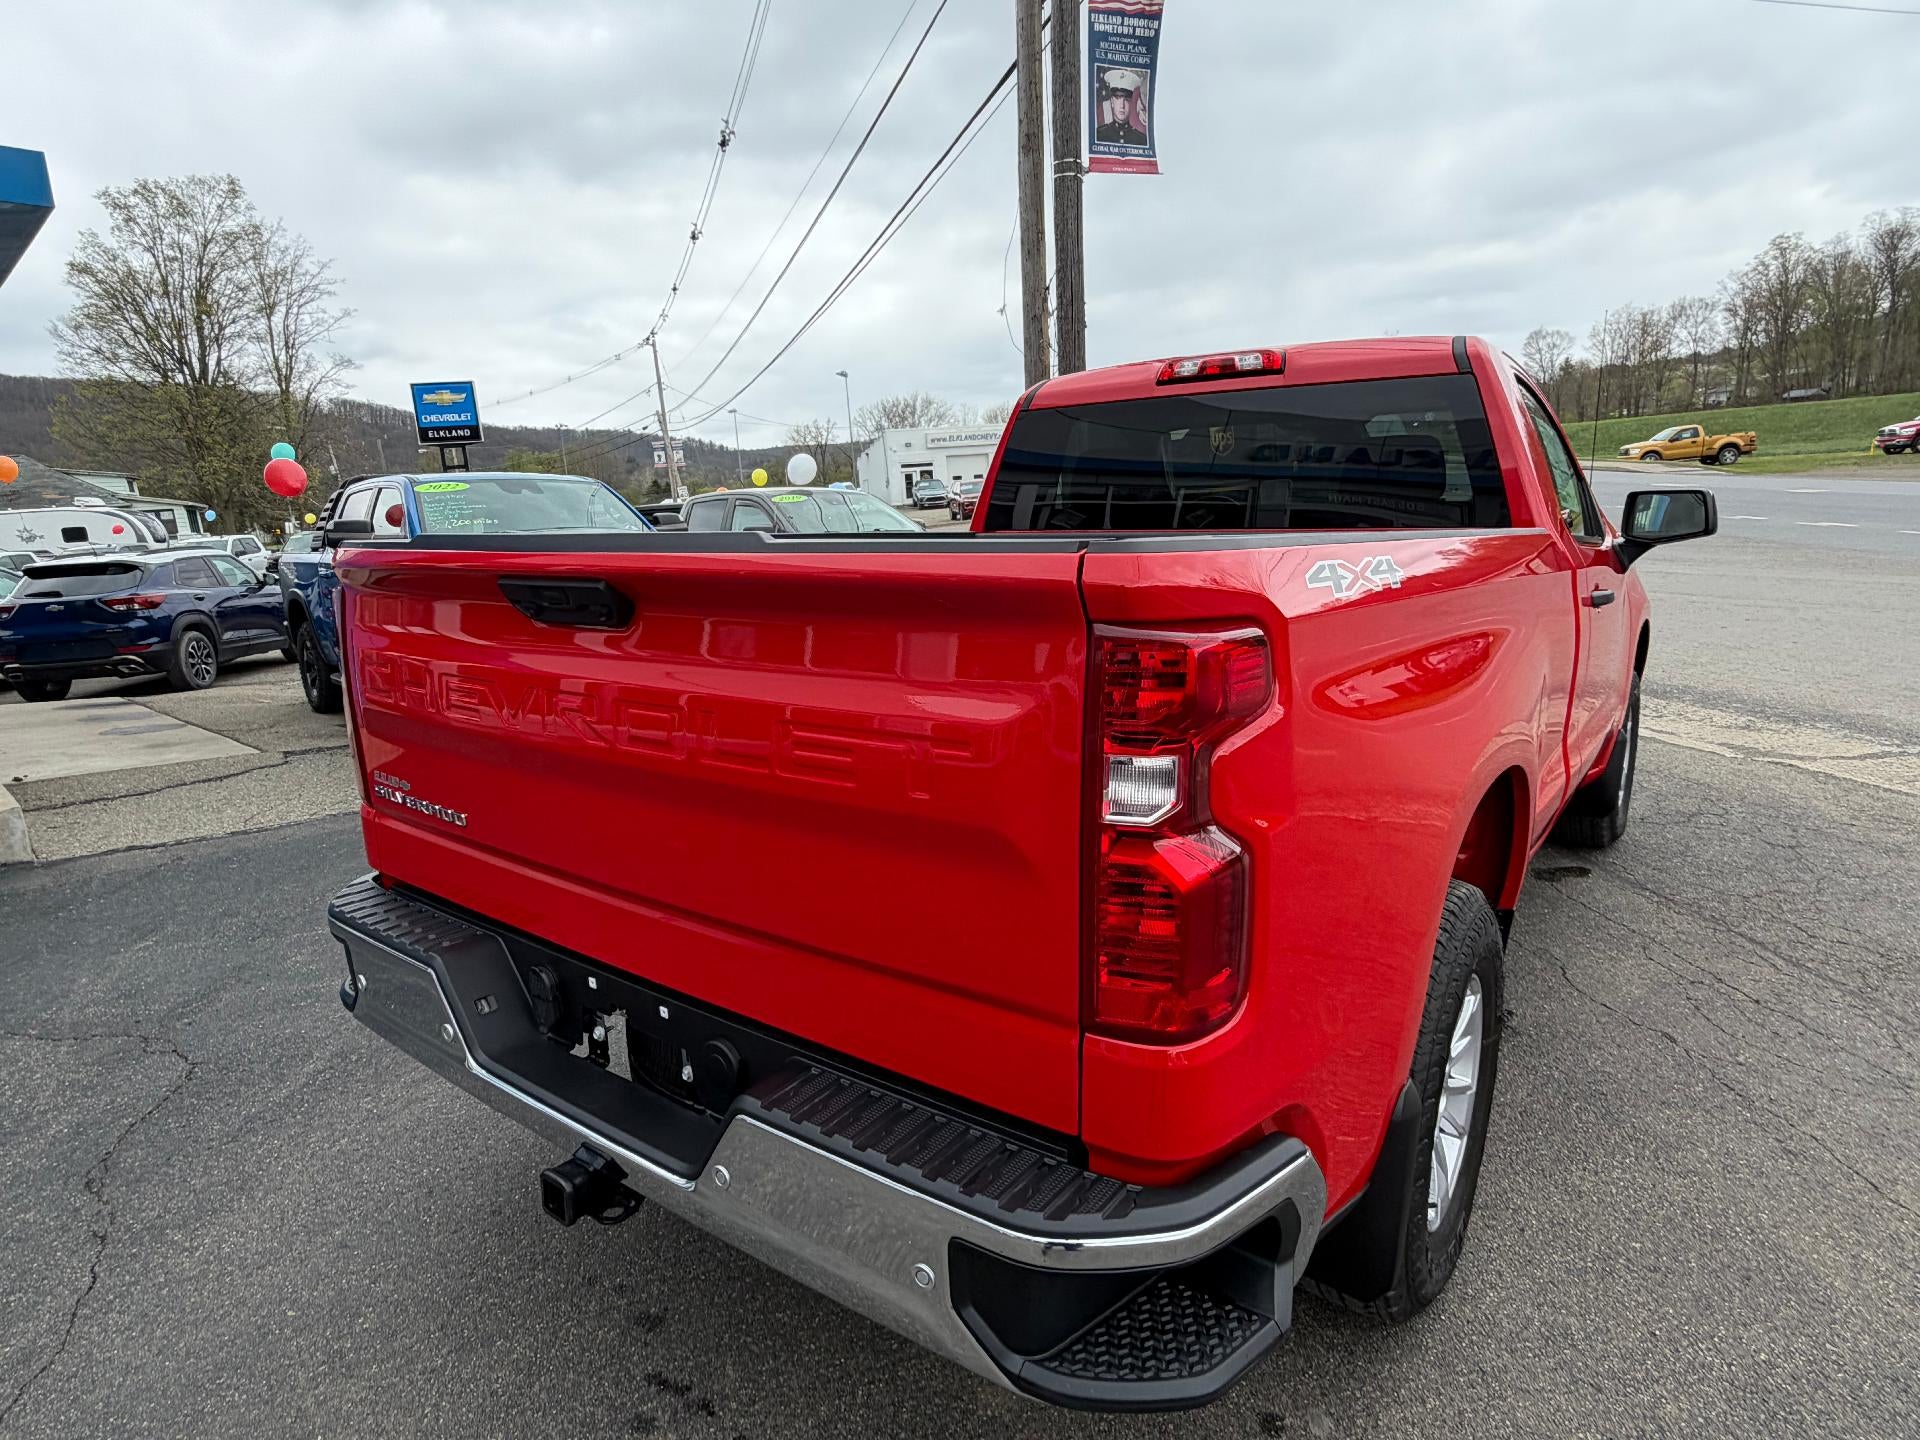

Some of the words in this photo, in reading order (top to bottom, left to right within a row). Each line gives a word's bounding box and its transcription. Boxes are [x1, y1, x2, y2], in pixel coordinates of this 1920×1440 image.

[1091, 14, 1121, 24] ELKLAND
[1123, 18, 1158, 28] BOROUGH
[1094, 23, 1133, 34] HOMETOWN
[1135, 27, 1155, 37] HERO
[1100, 41, 1125, 51] MICHAEL
[1127, 45, 1146, 53] PLANK
[1107, 53, 1129, 62] MARINE
[1130, 56, 1150, 64] CORPS
[421, 413, 471, 422] CHEVROLET
[428, 429, 470, 437] ELKLAND
[424, 483, 459, 491] 2022
[360, 648, 976, 800] CHEVROLET
[374, 783, 468, 828] SILVERADO
